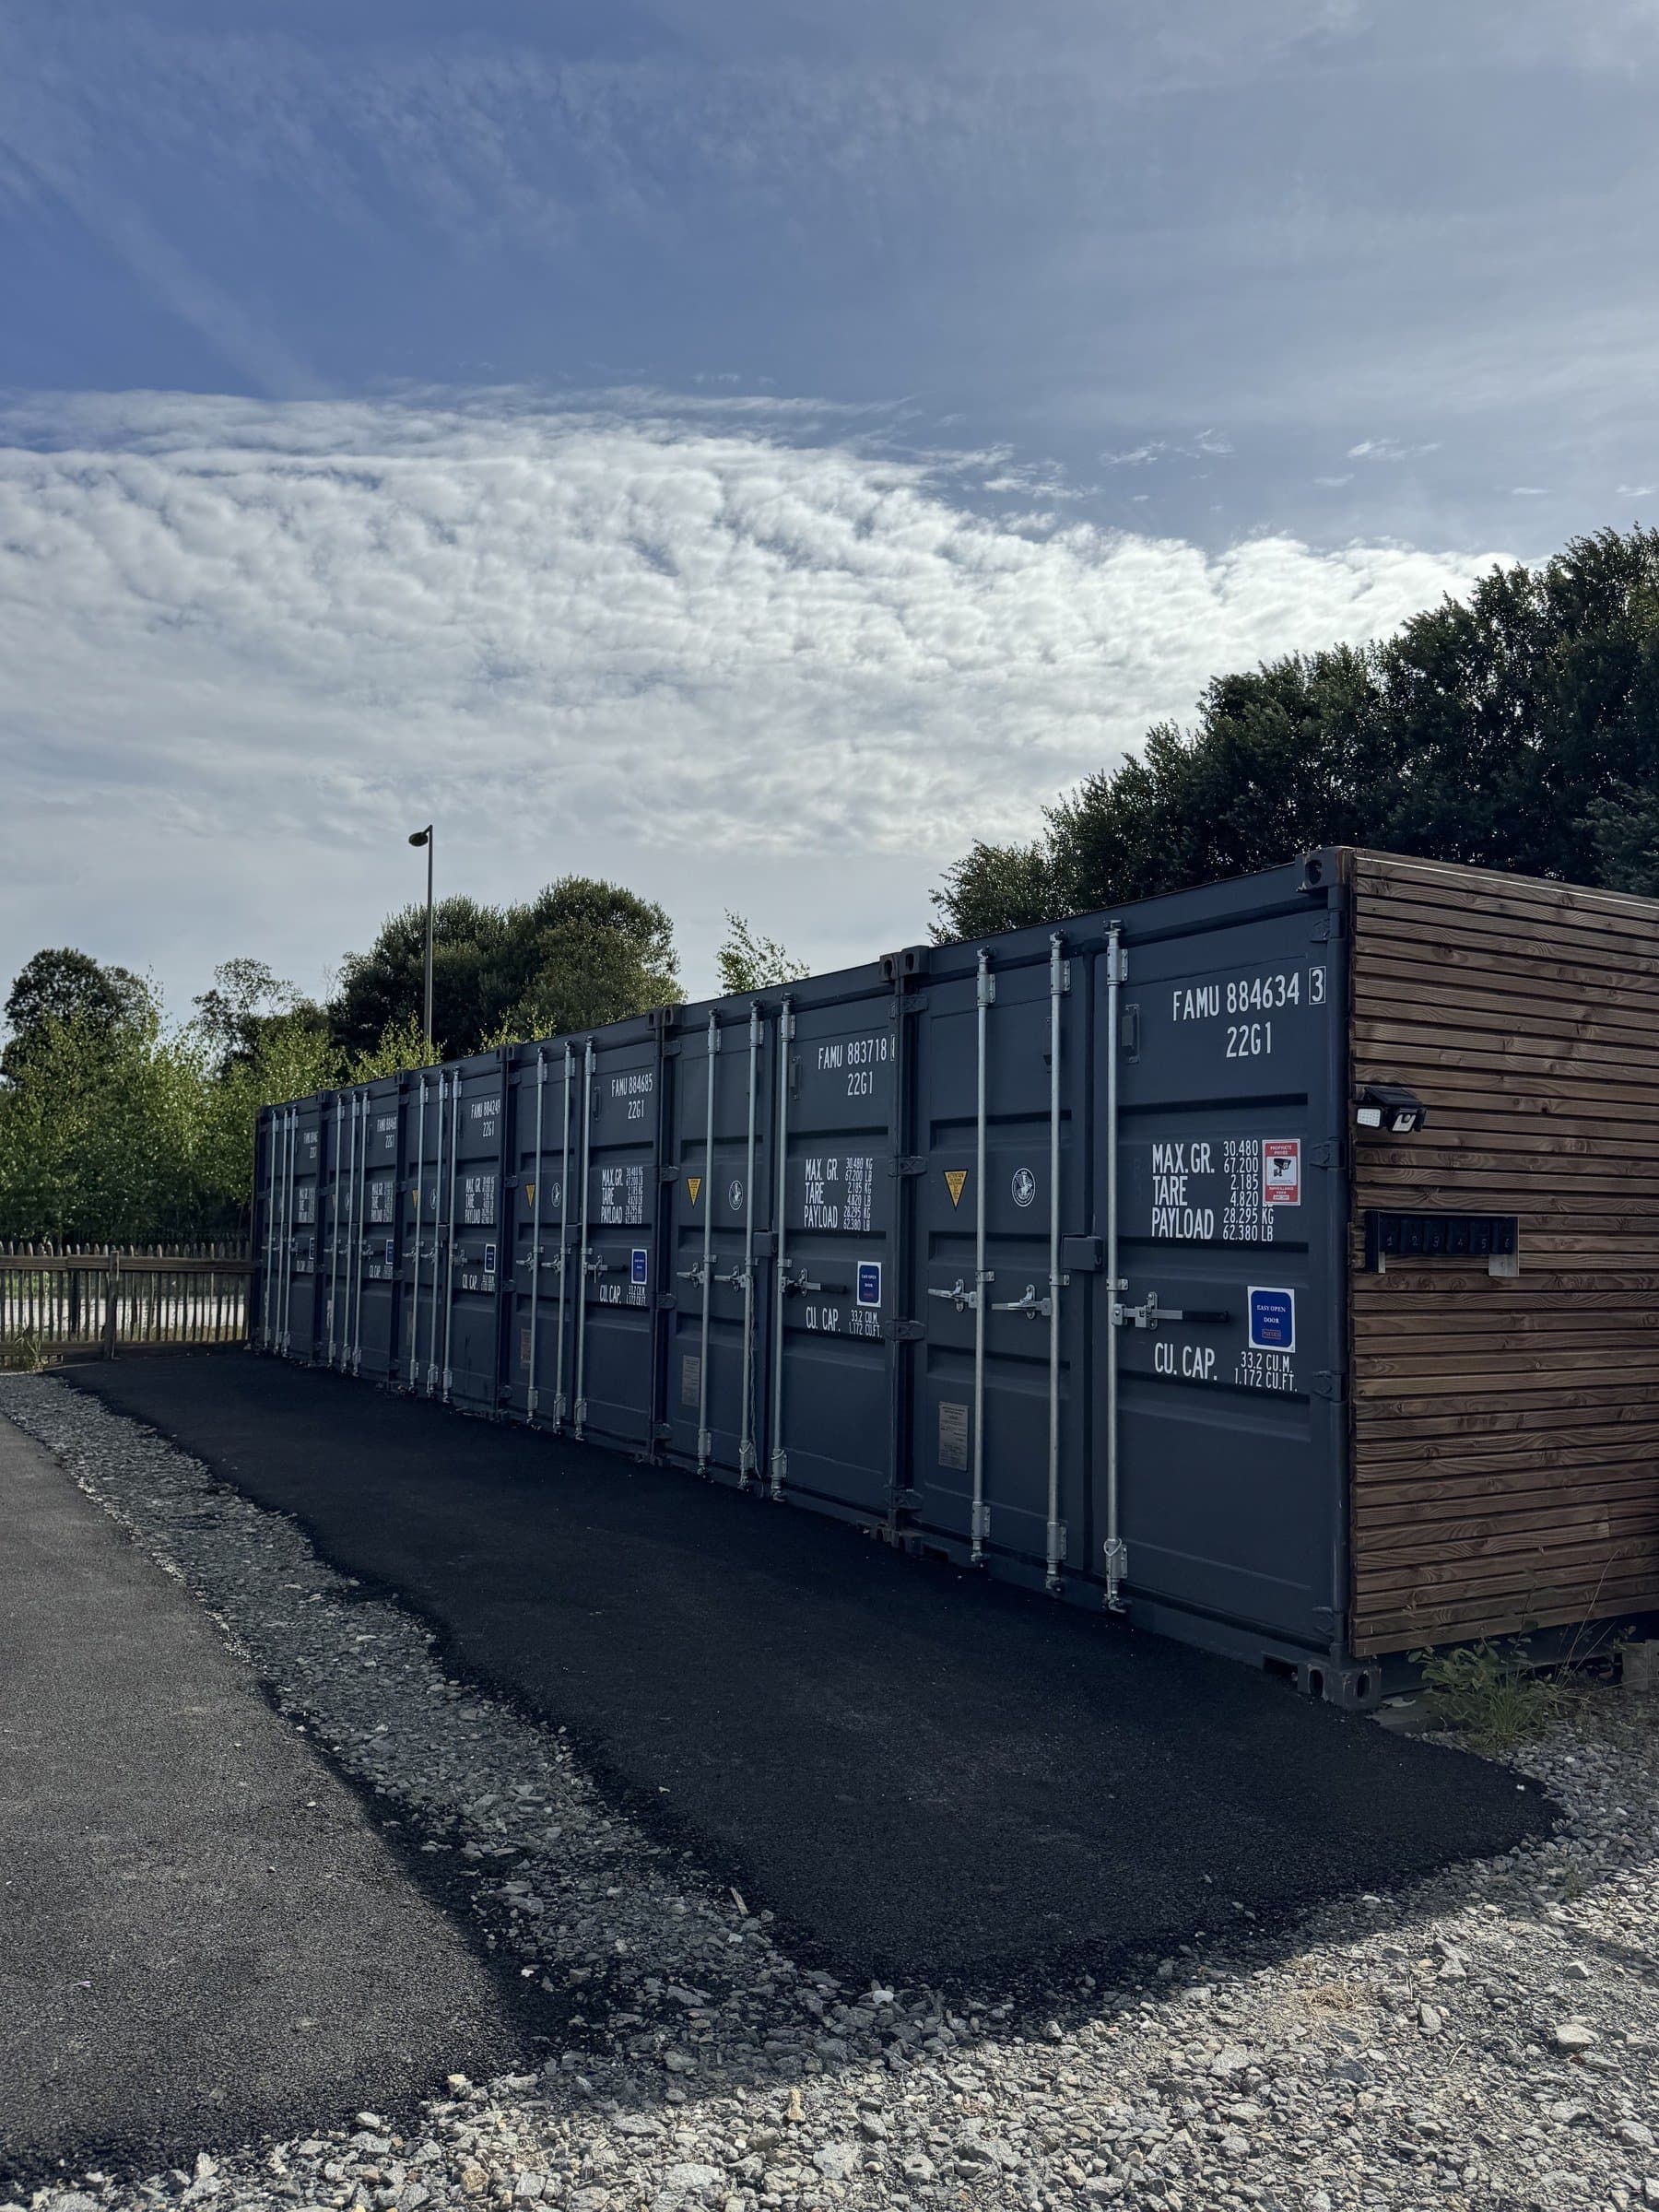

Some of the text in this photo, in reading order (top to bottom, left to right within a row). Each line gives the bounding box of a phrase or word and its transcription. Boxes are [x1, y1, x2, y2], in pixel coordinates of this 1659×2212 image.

[1173, 969, 1324, 1021] FAMU 884634 3
[1226, 1021, 1272, 1058] 22G1
[818, 1045, 842, 1069] FAMU
[848, 1038, 887, 1065] 883718
[612, 1077, 627, 1097] FAMU
[848, 1071, 873, 1096] 22G1
[628, 1100, 644, 1119] 22G1
[1152, 1140, 1258, 1173] MAX. GR. 30.480
[1223, 1157, 1258, 1173] 67.200
[806, 1159, 823, 1181] MAX.
[827, 1159, 839, 1181] GR.
[806, 1182, 824, 1204] TARE
[1152, 1174, 1258, 1206] TARE 2.185
[1230, 1191, 1258, 1207] 4.820
[804, 1206, 838, 1229] PAYLOAD
[1152, 1207, 1274, 1241] PAYLOAD 28.295 KG
[1222, 1224, 1274, 1241] 62.380 LB
[806, 1306, 818, 1329] CU.
[822, 1308, 841, 1332] CAP.
[1154, 1342, 1292, 1381] CU. CAP. 33.2 CU.M.
[1235, 1368, 1298, 1392] 1.172 CU.FT.
